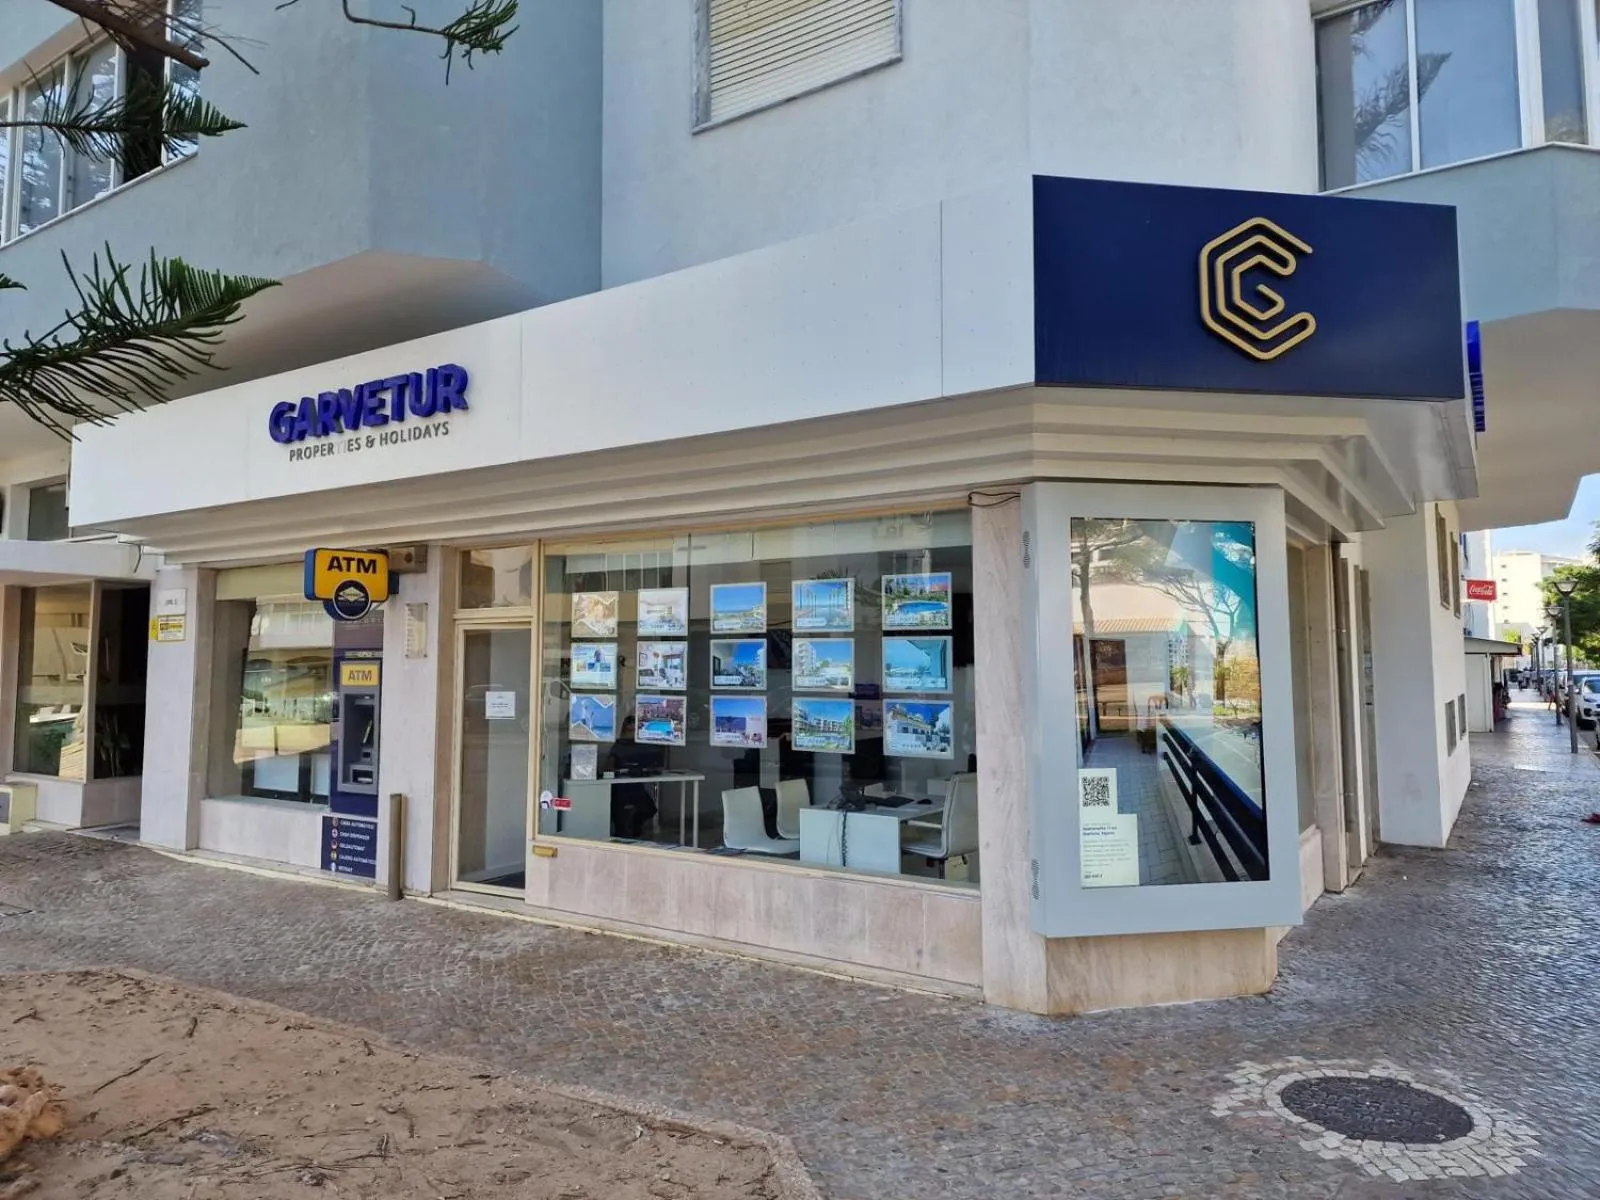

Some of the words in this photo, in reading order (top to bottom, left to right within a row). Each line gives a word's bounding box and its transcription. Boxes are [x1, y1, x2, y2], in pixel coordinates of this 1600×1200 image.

[268, 363, 469, 444] GARVETUR
[365, 435, 375, 449] &
[380, 421, 449, 446] HOLIDAYS
[327, 556, 377, 574] ATM
[348, 670, 372, 681] ATM
